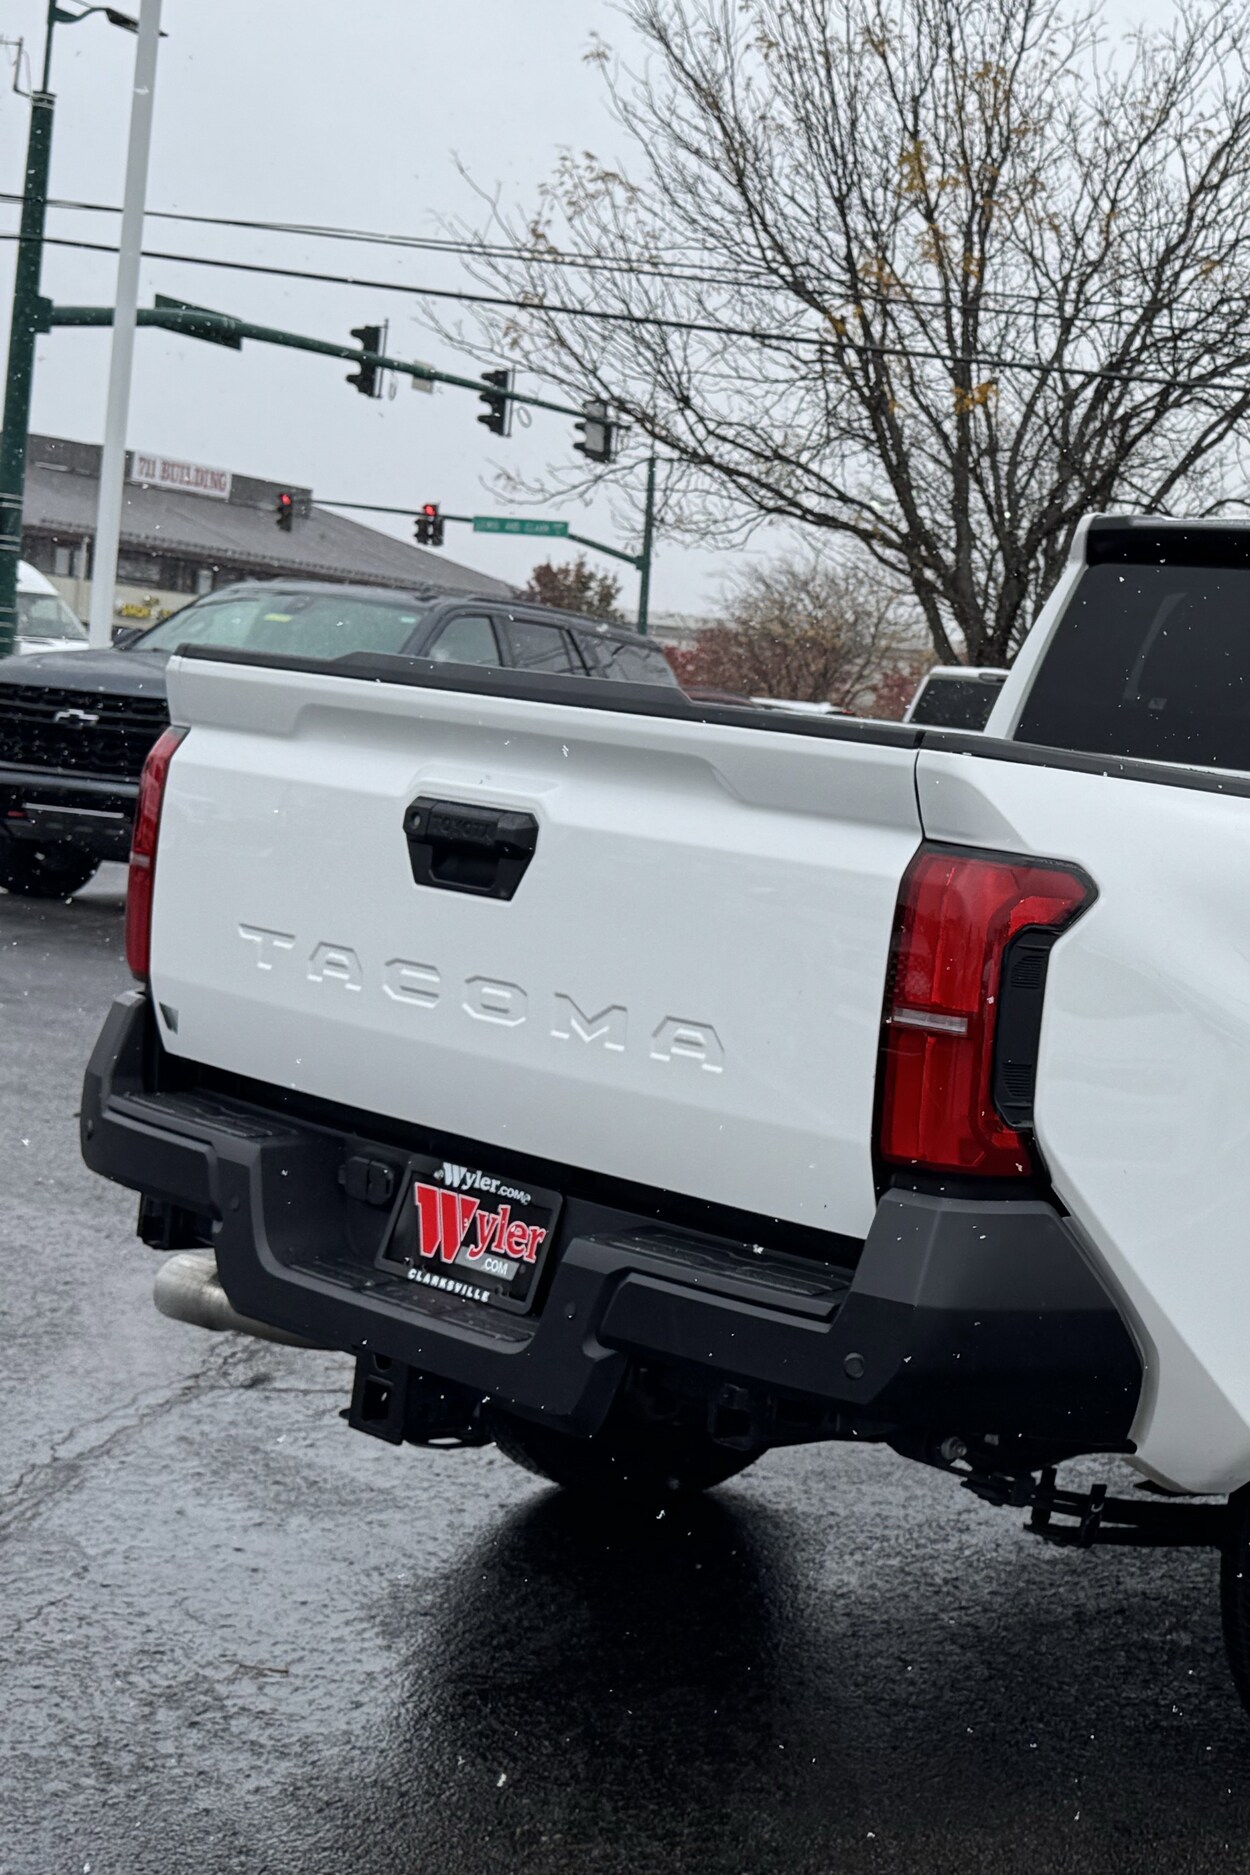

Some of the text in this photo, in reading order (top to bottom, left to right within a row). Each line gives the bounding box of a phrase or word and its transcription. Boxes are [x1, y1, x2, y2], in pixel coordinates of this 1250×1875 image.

[161, 460, 226, 493] BUILDING
[238, 922, 725, 1073] TACOMA
[414, 1182, 546, 1264] Wyler
[407, 1268, 490, 1302] CLARKSVILLE
